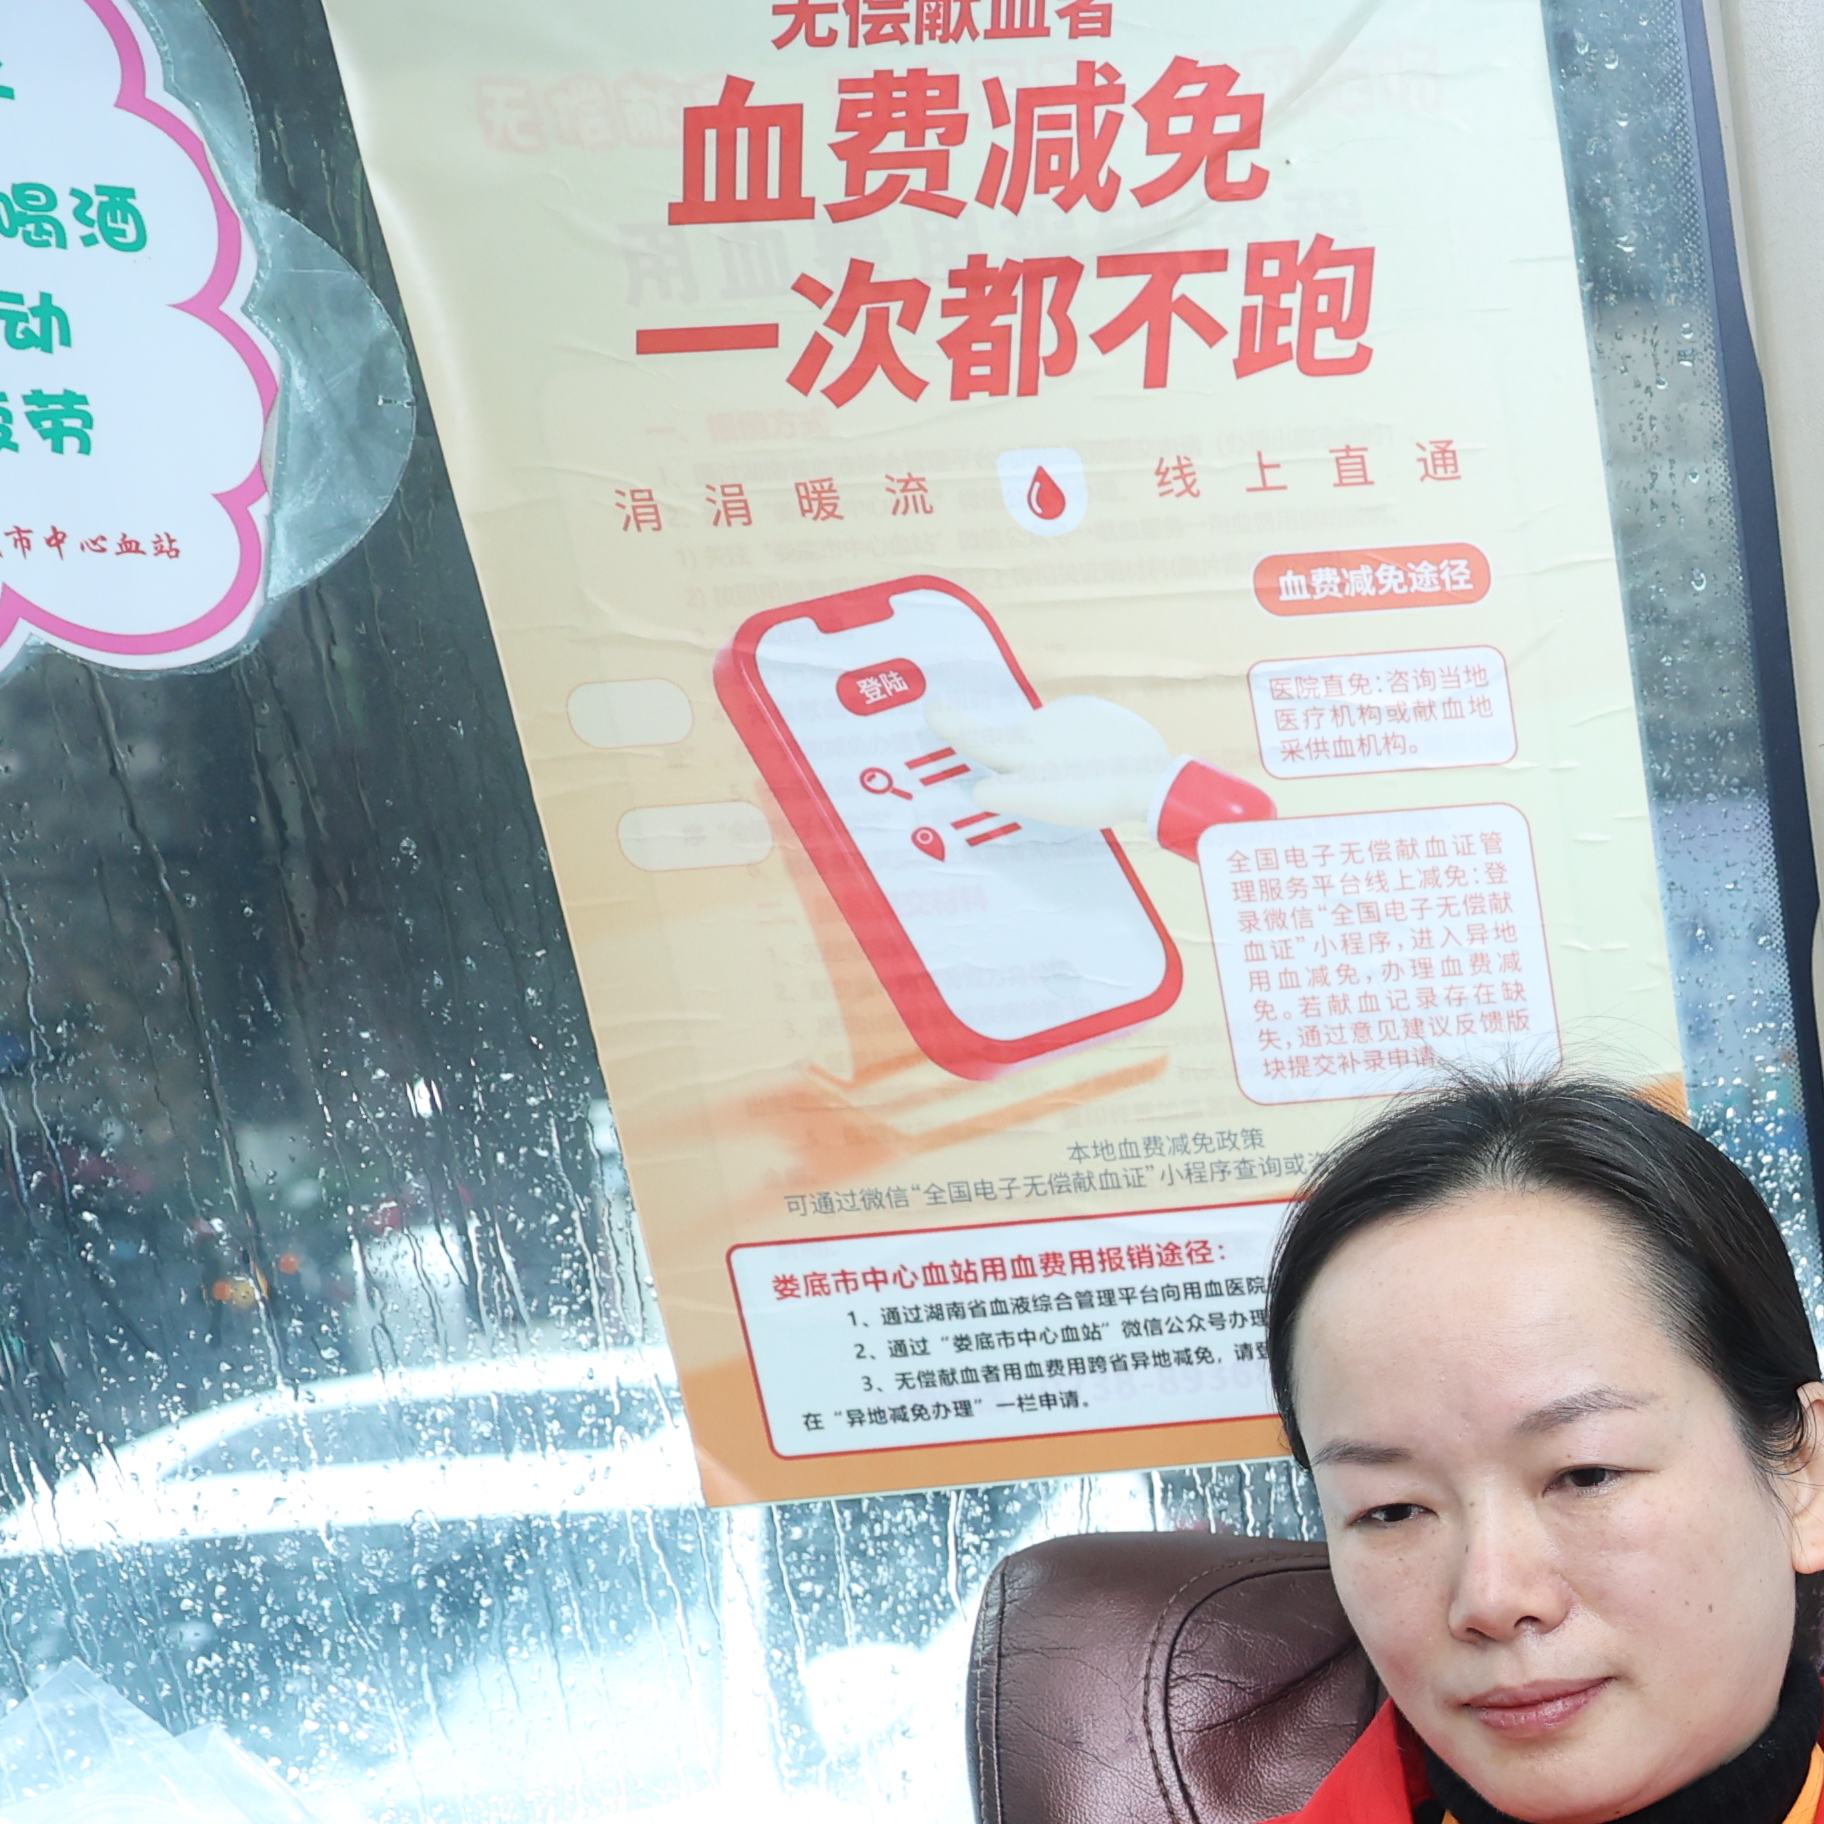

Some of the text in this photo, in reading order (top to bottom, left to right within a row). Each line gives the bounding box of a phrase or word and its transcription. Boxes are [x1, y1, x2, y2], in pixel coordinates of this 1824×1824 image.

[771, 0, 1112, 50] 无偿献血者
[667, 55, 1271, 225] 血费减免
[0, 183, 148, 253] 喝酒
[634, 233, 1375, 408] 一次都不跑
[614, 439, 1463, 534] 涓涓暖流 线上直通
[0, 526, 181, 560] 市中心血站
[1278, 559, 1474, 601] 血费减免途径
[856, 669, 910, 706] 登陆
[1275, 695, 1493, 731] 医疗机构或献血地
[1280, 732, 1418, 762] 采供血机构。
[1226, 832, 1503, 875] 全国电子无偿献血证管
[1238, 891, 1514, 933] 录微信“全国电子无偿献
[1248, 951, 1522, 992] 用血减免，办理血费减
[1254, 981, 1527, 1022] 免。若献血记录存在缺
[1067, 1127, 1265, 1165] 本地血费减免政策
[772, 1239, 1227, 1300] 娄底市中心血站用血费用报销途径：
[847, 1275, 1268, 1328] 1、通过湖南省血液综合管理平台向用血医院
